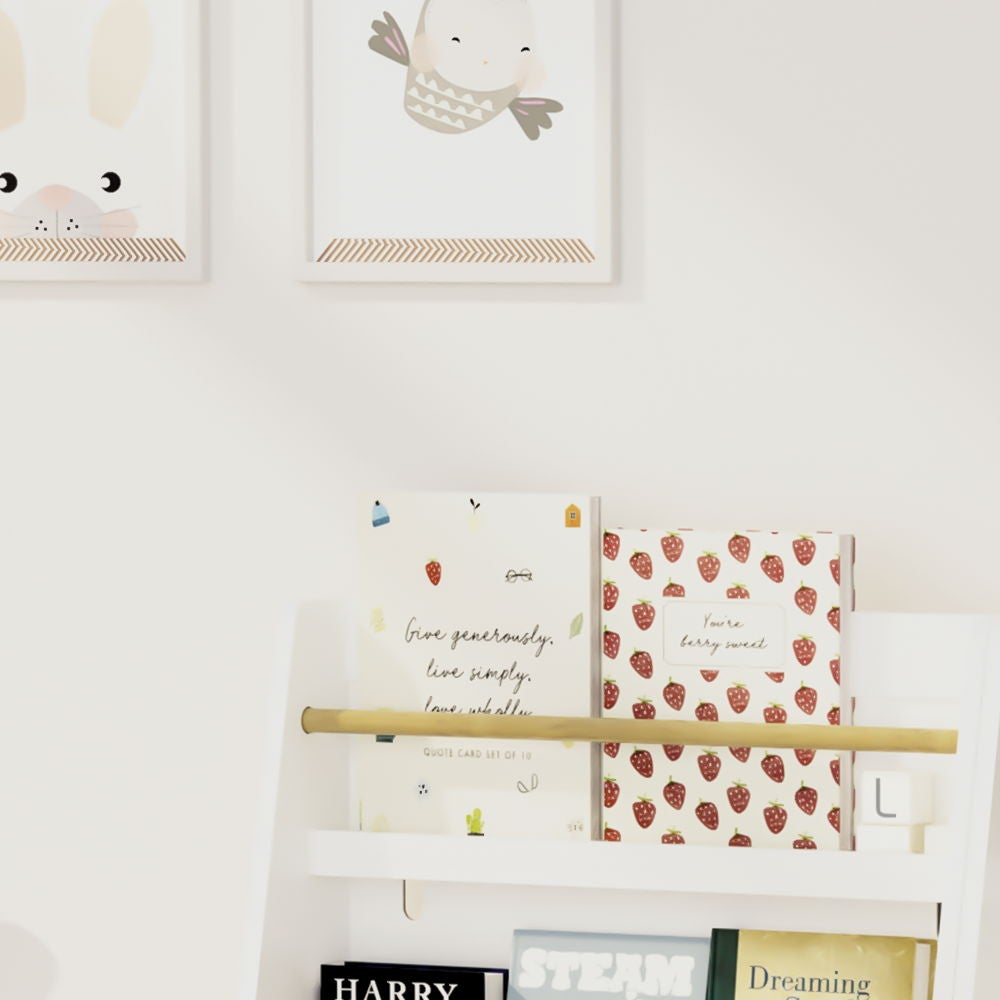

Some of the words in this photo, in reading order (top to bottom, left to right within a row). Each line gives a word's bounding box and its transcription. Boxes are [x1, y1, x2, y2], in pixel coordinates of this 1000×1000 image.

[404, 616, 447, 643] Give
[450, 623, 554, 658] generously.
[703, 611, 745, 629] You're
[679, 633, 721, 656] berry
[725, 635, 769, 649] sweet
[425, 657, 464, 679] live
[469, 660, 532, 695] simply.
[423, 747, 453, 758] QUOTE
[457, 748, 482, 759] CARD
[504, 750, 516, 760] OF
[521, 750, 532, 761] 10
[875, 777, 897, 818] L
[517, 946, 696, 998] STEAM
